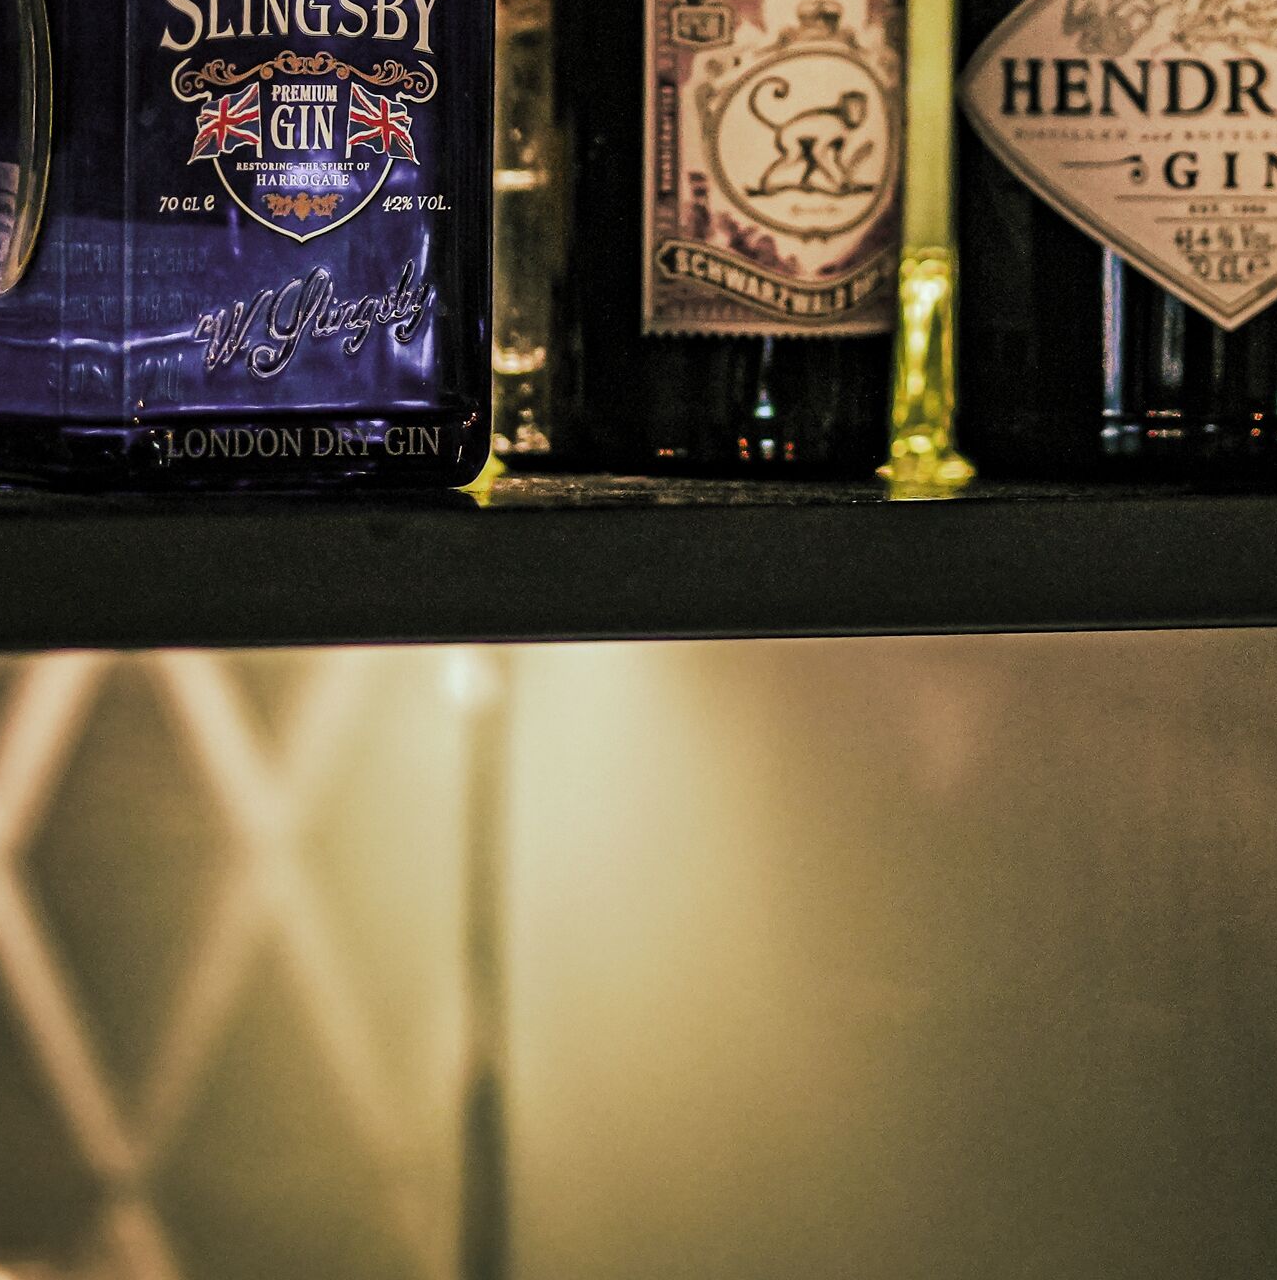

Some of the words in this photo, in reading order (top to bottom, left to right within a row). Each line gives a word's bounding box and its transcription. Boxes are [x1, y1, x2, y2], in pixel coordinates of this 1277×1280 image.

[271, 84, 338, 103] PREMIUM
[270, 103, 337, 150] GIN
[299, 162, 322, 171] THE
[322, 162, 354, 171] SPIRIT
[357, 162, 371, 171] OF
[256, 173, 350, 187] HARROGATE
[158, 195, 179, 213] 70
[382, 195, 413, 212] 42%
[418, 195, 453, 211] VOL.
[166, 428, 304, 458] LONDON
[313, 427, 376, 457] DRY
[384, 426, 441, 457] GIN
